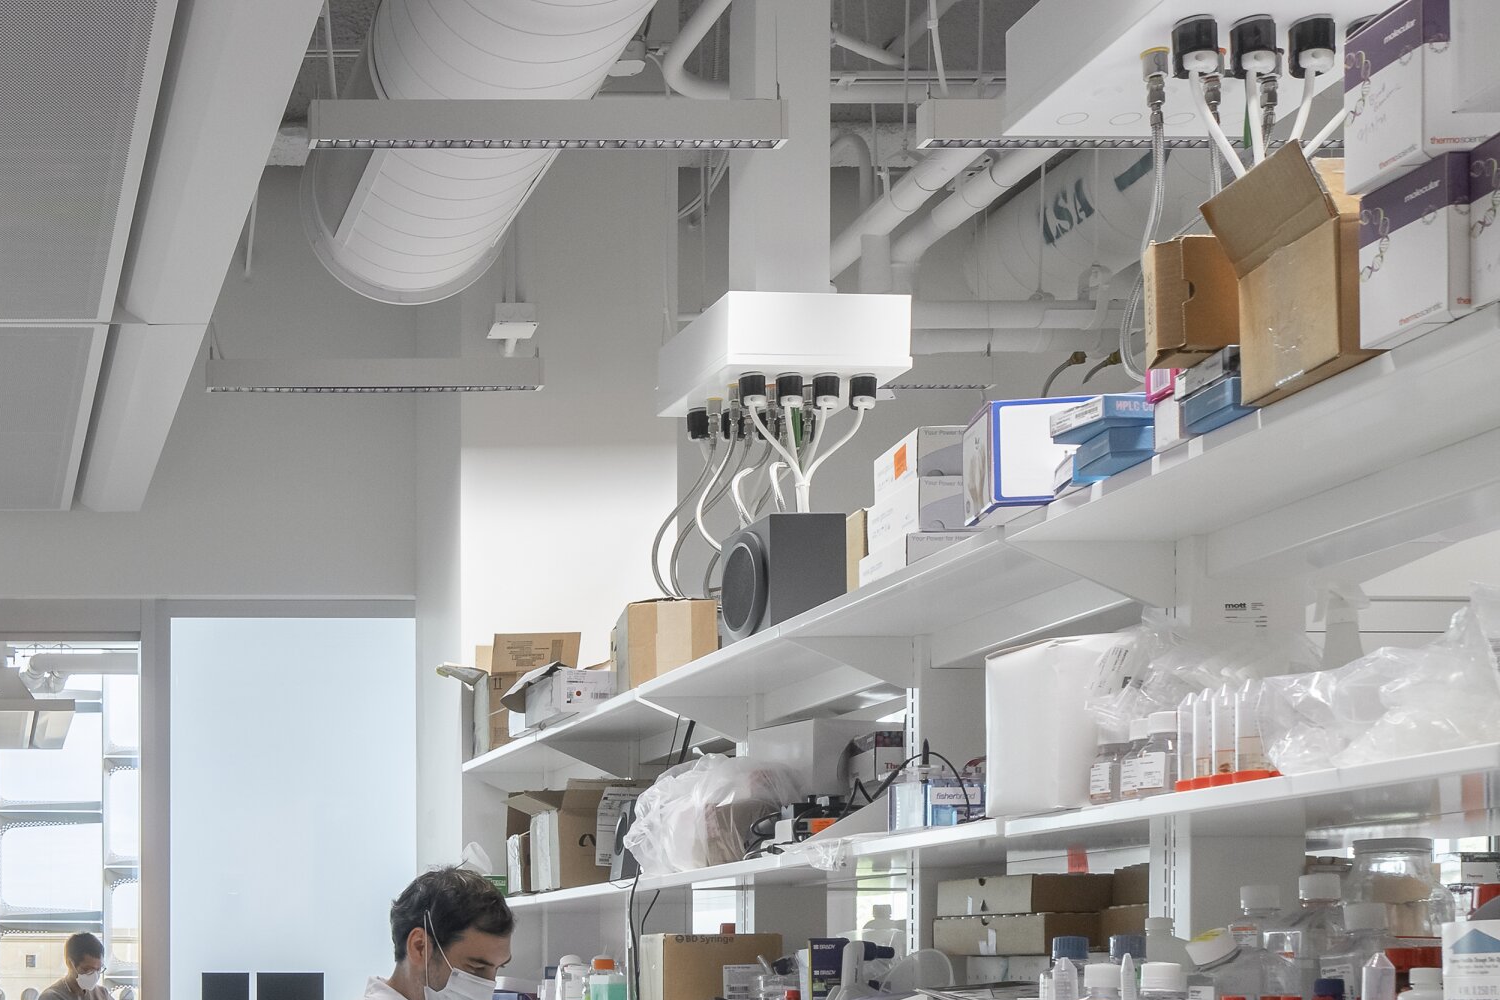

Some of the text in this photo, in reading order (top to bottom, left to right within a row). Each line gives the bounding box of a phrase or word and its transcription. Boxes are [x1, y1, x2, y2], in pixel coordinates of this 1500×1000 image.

[1403, 180, 1441, 203] molecular
[1115, 401, 1141, 411] HPLC
[685, 935, 734, 945] BD Syringe
